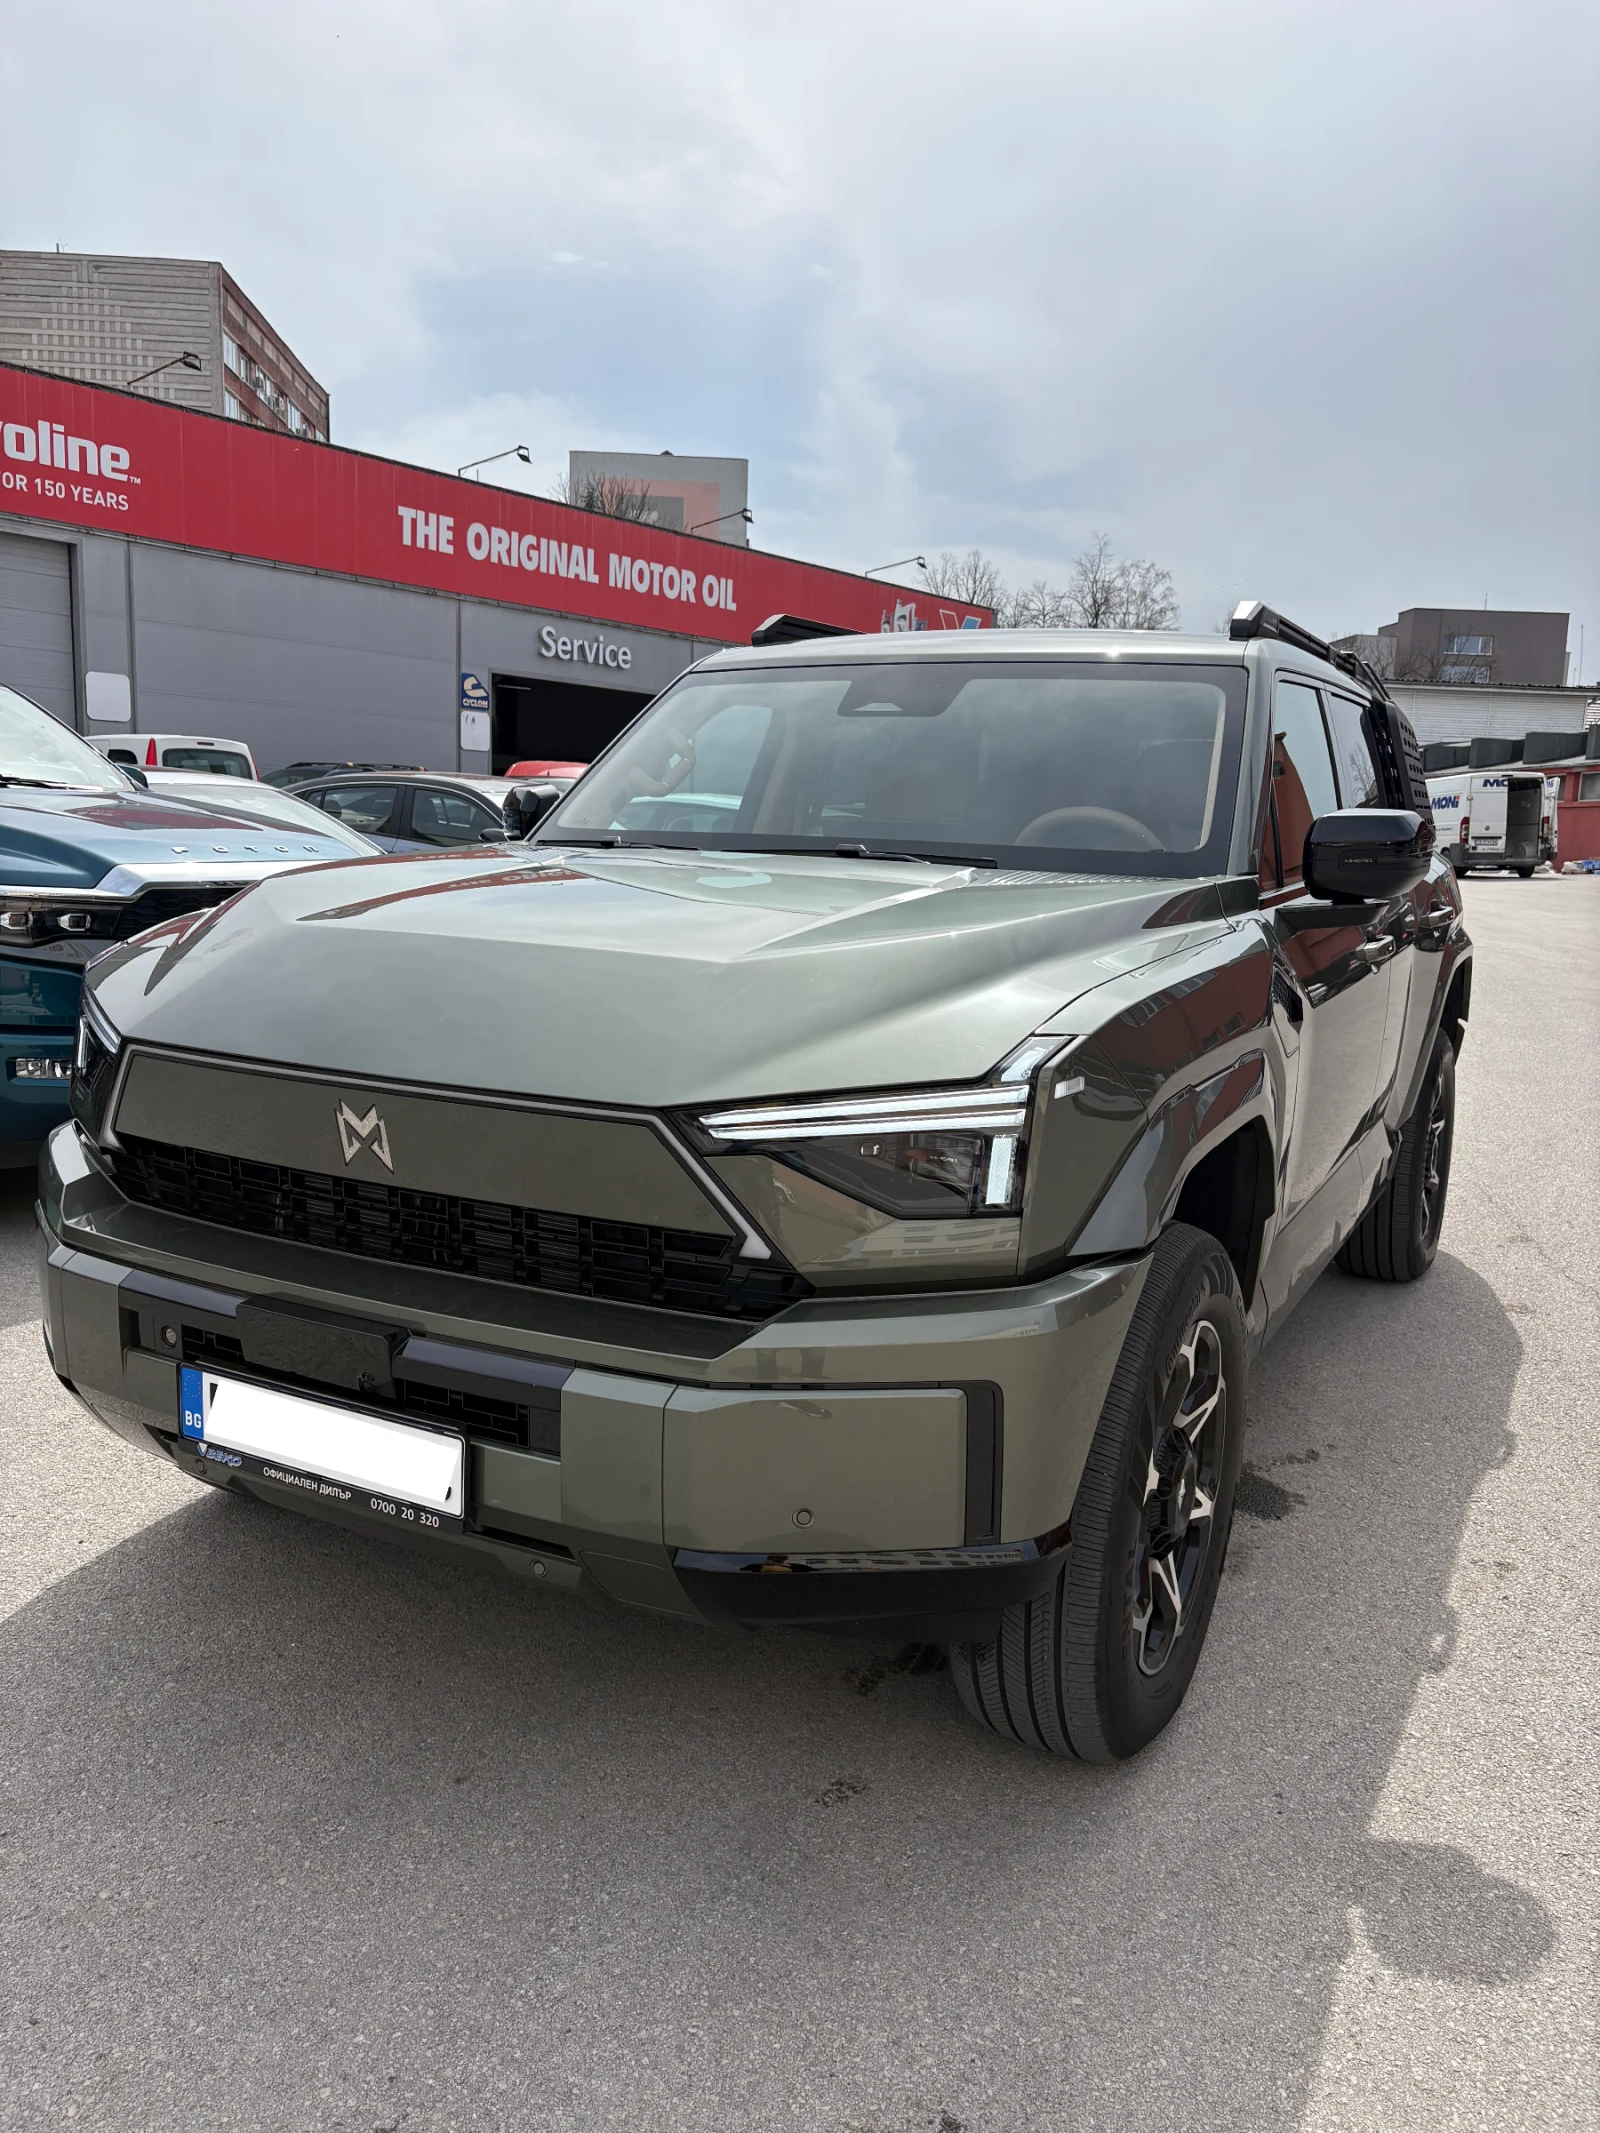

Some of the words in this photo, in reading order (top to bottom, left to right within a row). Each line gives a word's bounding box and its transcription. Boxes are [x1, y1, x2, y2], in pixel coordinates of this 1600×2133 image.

[0, 420, 130, 482] oline
[0, 471, 28, 493] OR
[34, 478, 66, 499] 150
[69, 484, 129, 511] YEARS
[398, 505, 454, 555] THE
[466, 522, 599, 584] ORIGINAL
[608, 553, 697, 604] MOTOR
[702, 574, 737, 612] OIL
[540, 625, 632, 670] Service
[185, 1410, 202, 1429] BG
[263, 1467, 318, 1492] ОФИЦИАЛЕН
[319, 1484, 352, 1501] ДИЛЪР
[370, 1498, 397, 1516] 0700
[401, 1507, 415, 1521] 20
[419, 1512, 440, 1528] 320
